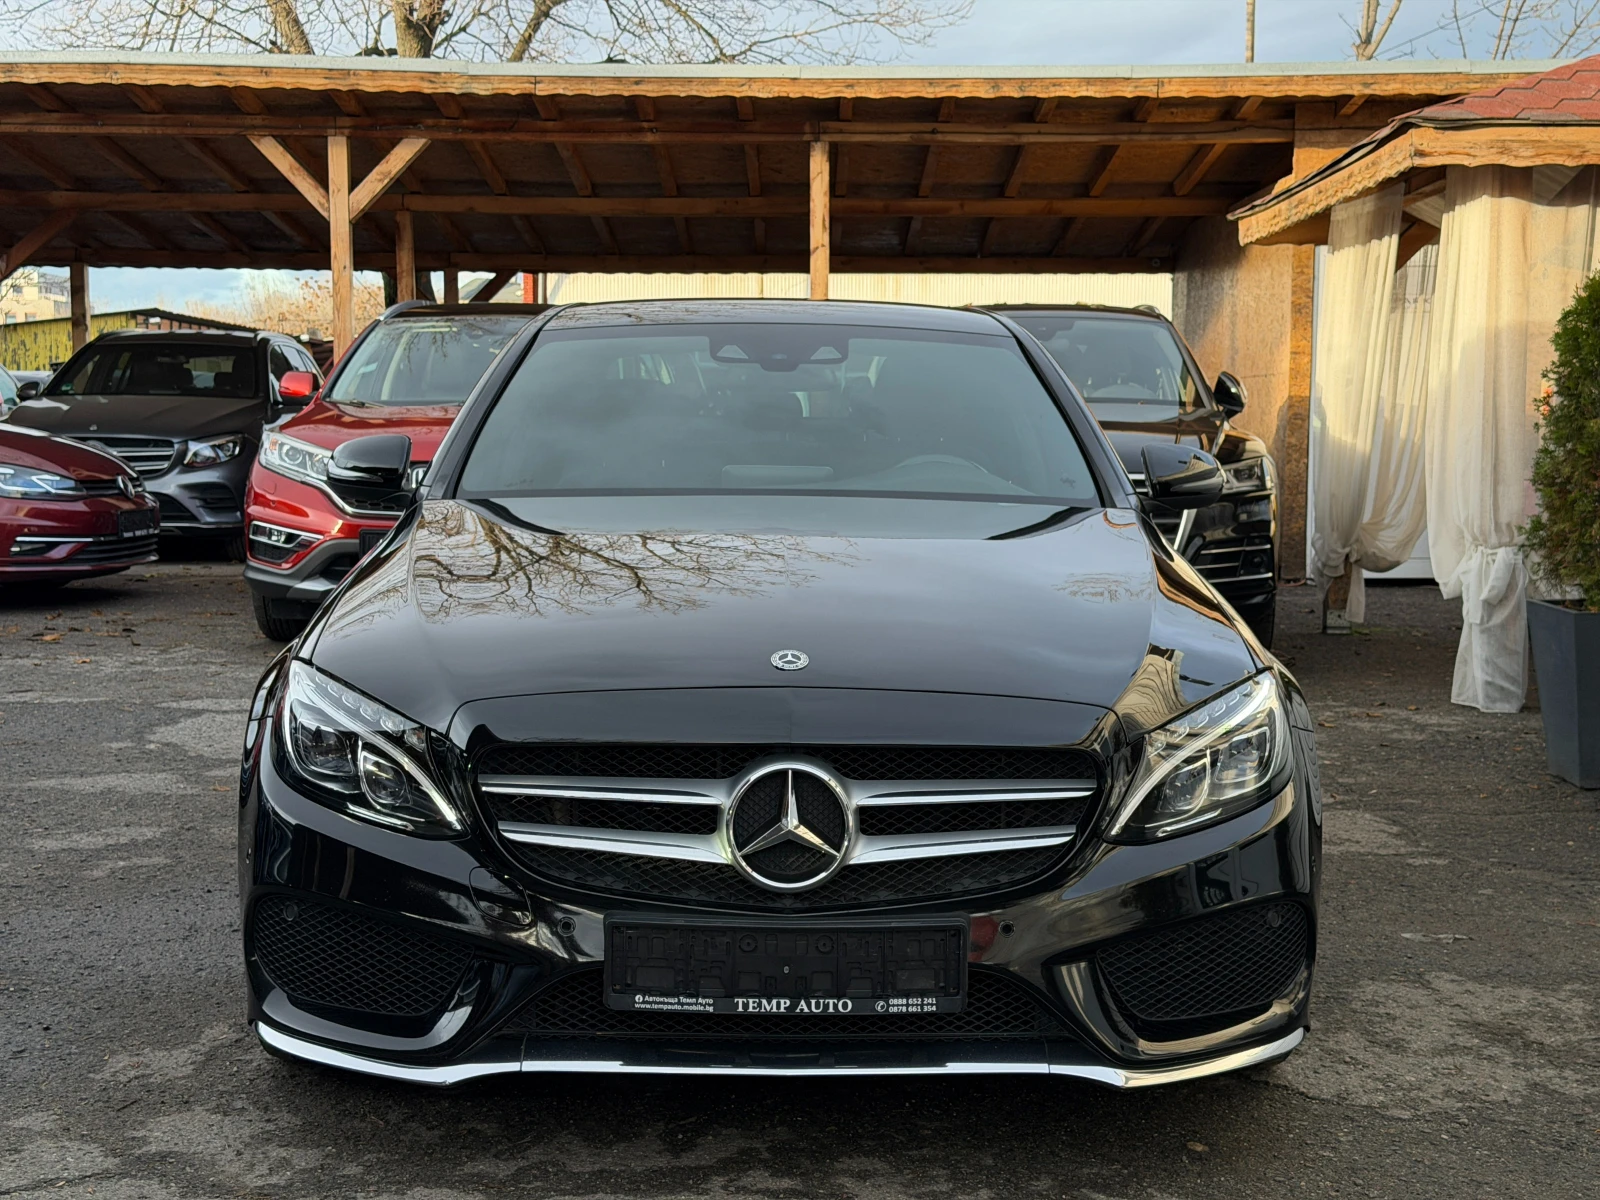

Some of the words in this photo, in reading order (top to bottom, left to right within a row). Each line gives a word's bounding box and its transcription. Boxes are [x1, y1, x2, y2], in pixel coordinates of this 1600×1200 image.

[644, 995, 678, 1003] Автокъща
[679, 996, 697, 1004] Темп
[698, 997, 714, 1005] Ауто
[634, 1003, 714, 1012] www.tempauto.mobile.bg
[735, 998, 790, 1012] TEMP
[795, 999, 853, 1013] AUTO
